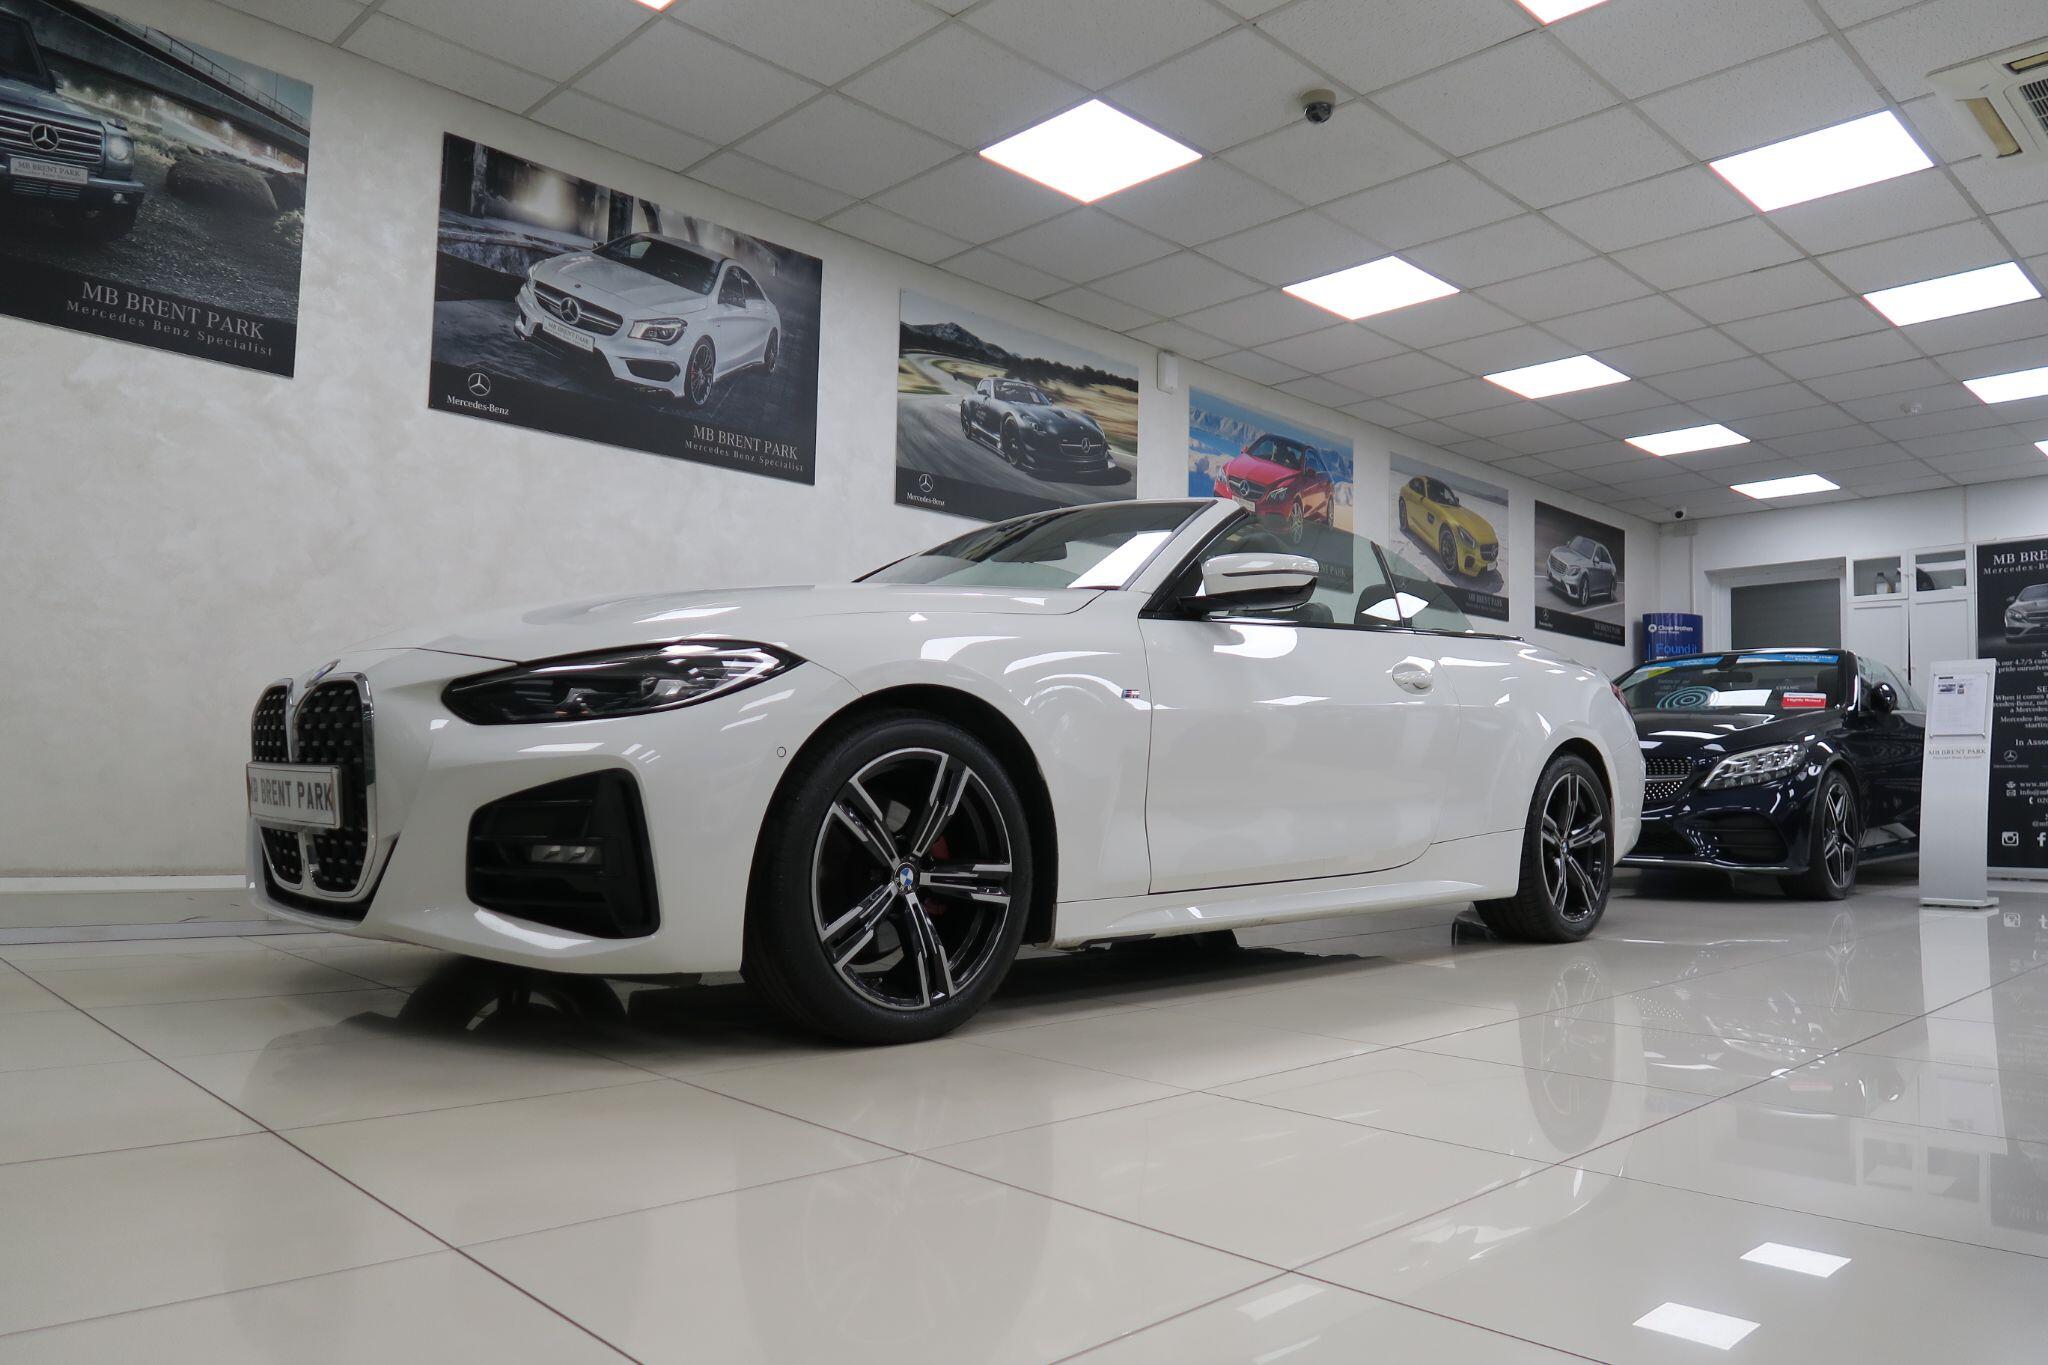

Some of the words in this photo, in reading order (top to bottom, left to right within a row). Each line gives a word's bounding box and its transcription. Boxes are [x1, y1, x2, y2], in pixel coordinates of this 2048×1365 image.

[82, 281, 119, 306] MB
[125, 291, 201, 325] BRENT
[207, 311, 265, 341] PARK
[66, 300, 145, 328] Mercedes
[152, 320, 190, 338] Benz
[197, 330, 272, 356] Specialist
[446, 394, 509, 416] Mercedes-Benz
[684, 439, 730, 459] Mercedes
[733, 450, 756, 462] Benz
[759, 454, 804, 473] Specialist
[692, 424, 714, 443] MB
[718, 430, 761, 452] BRENT
[764, 440, 799, 460] PARK
[906, 492, 945, 506] Mercedes-Benz
[1993, 553, 2015, 565] MB
[2015, 738, 2024, 746] In
[260, 778, 291, 808] BRENT
[297, 781, 333, 811] PARK
